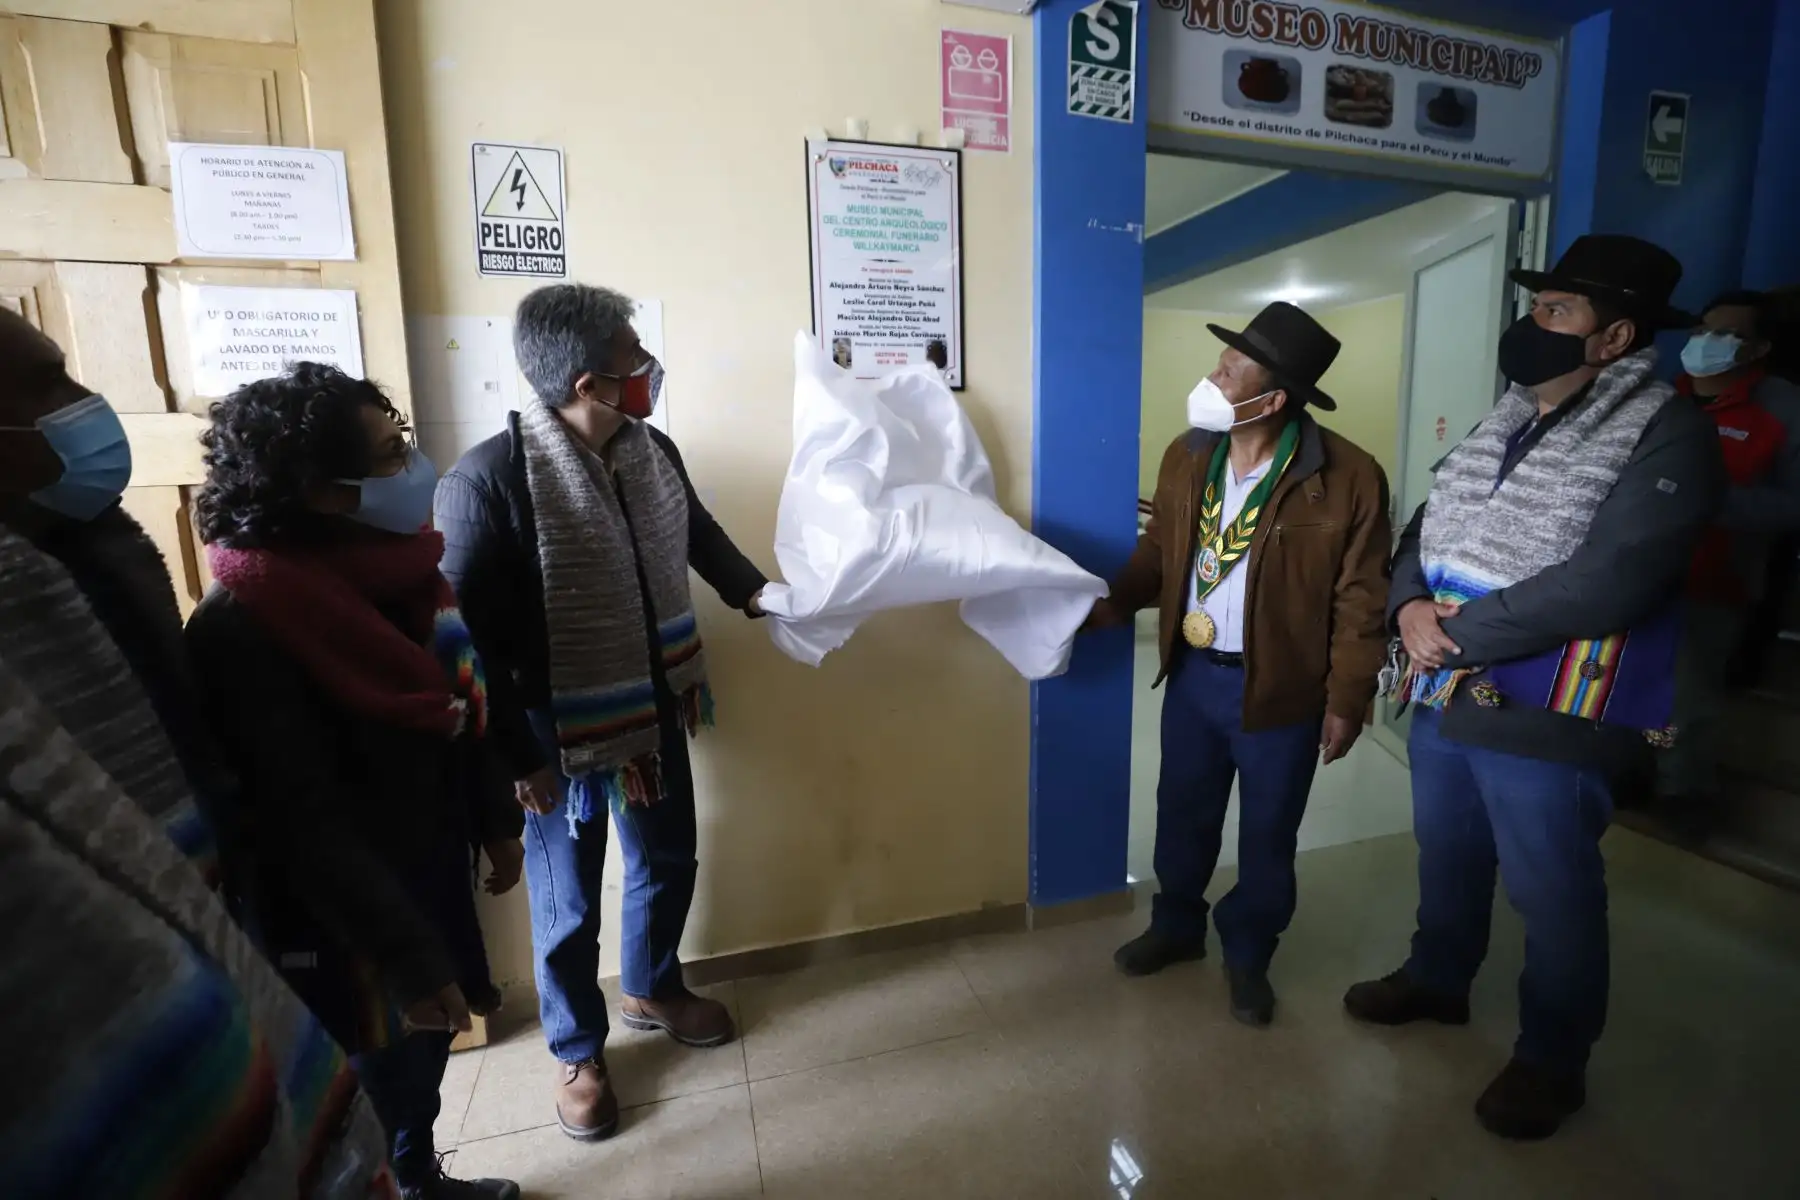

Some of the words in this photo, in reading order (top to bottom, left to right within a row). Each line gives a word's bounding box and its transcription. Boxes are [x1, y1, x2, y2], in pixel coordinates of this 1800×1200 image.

[1086, 7, 1120, 62] S
[1238, 119, 1250, 129] el
[1255, 119, 1301, 136] distrito
[1305, 127, 1321, 138] de
[1325, 130, 1377, 146] Pilchaca
[1381, 140, 1406, 151] para
[1410, 143, 1420, 153] el
[1452, 150, 1458, 160] y
[1461, 150, 1471, 160] el
[200, 157, 242, 166] HORARIO
[257, 158, 302, 169] ATENCIÓN
[304, 162, 315, 170] AL
[849, 160, 899, 172] PILCHACA
[212, 168, 250, 178] PÚBLICO
[267, 172, 306, 181] GENERAL
[847, 204, 878, 214] MUSEO
[880, 206, 924, 218] MUNICIPAL
[823, 215, 841, 224] DEL
[842, 216, 878, 226] CENTRO
[480, 222, 562, 250] PELIGRO
[833, 228, 887, 240] CEREMONIAL
[891, 230, 939, 242] FUNERARIO
[482, 254, 515, 270] RIESGO
[829, 282, 865, 290] Alejandro
[208, 310, 234, 320] UO
[238, 310, 320, 321] OBLIGATORIO
[324, 312, 338, 322] DE
[868, 314, 903, 324] Alejandro
[233, 328, 309, 338] MASCARILLA
[311, 328, 319, 338] Y
[272, 345, 287, 354] DE
[291, 345, 336, 355] MANOS
[263, 361, 278, 371] DE
